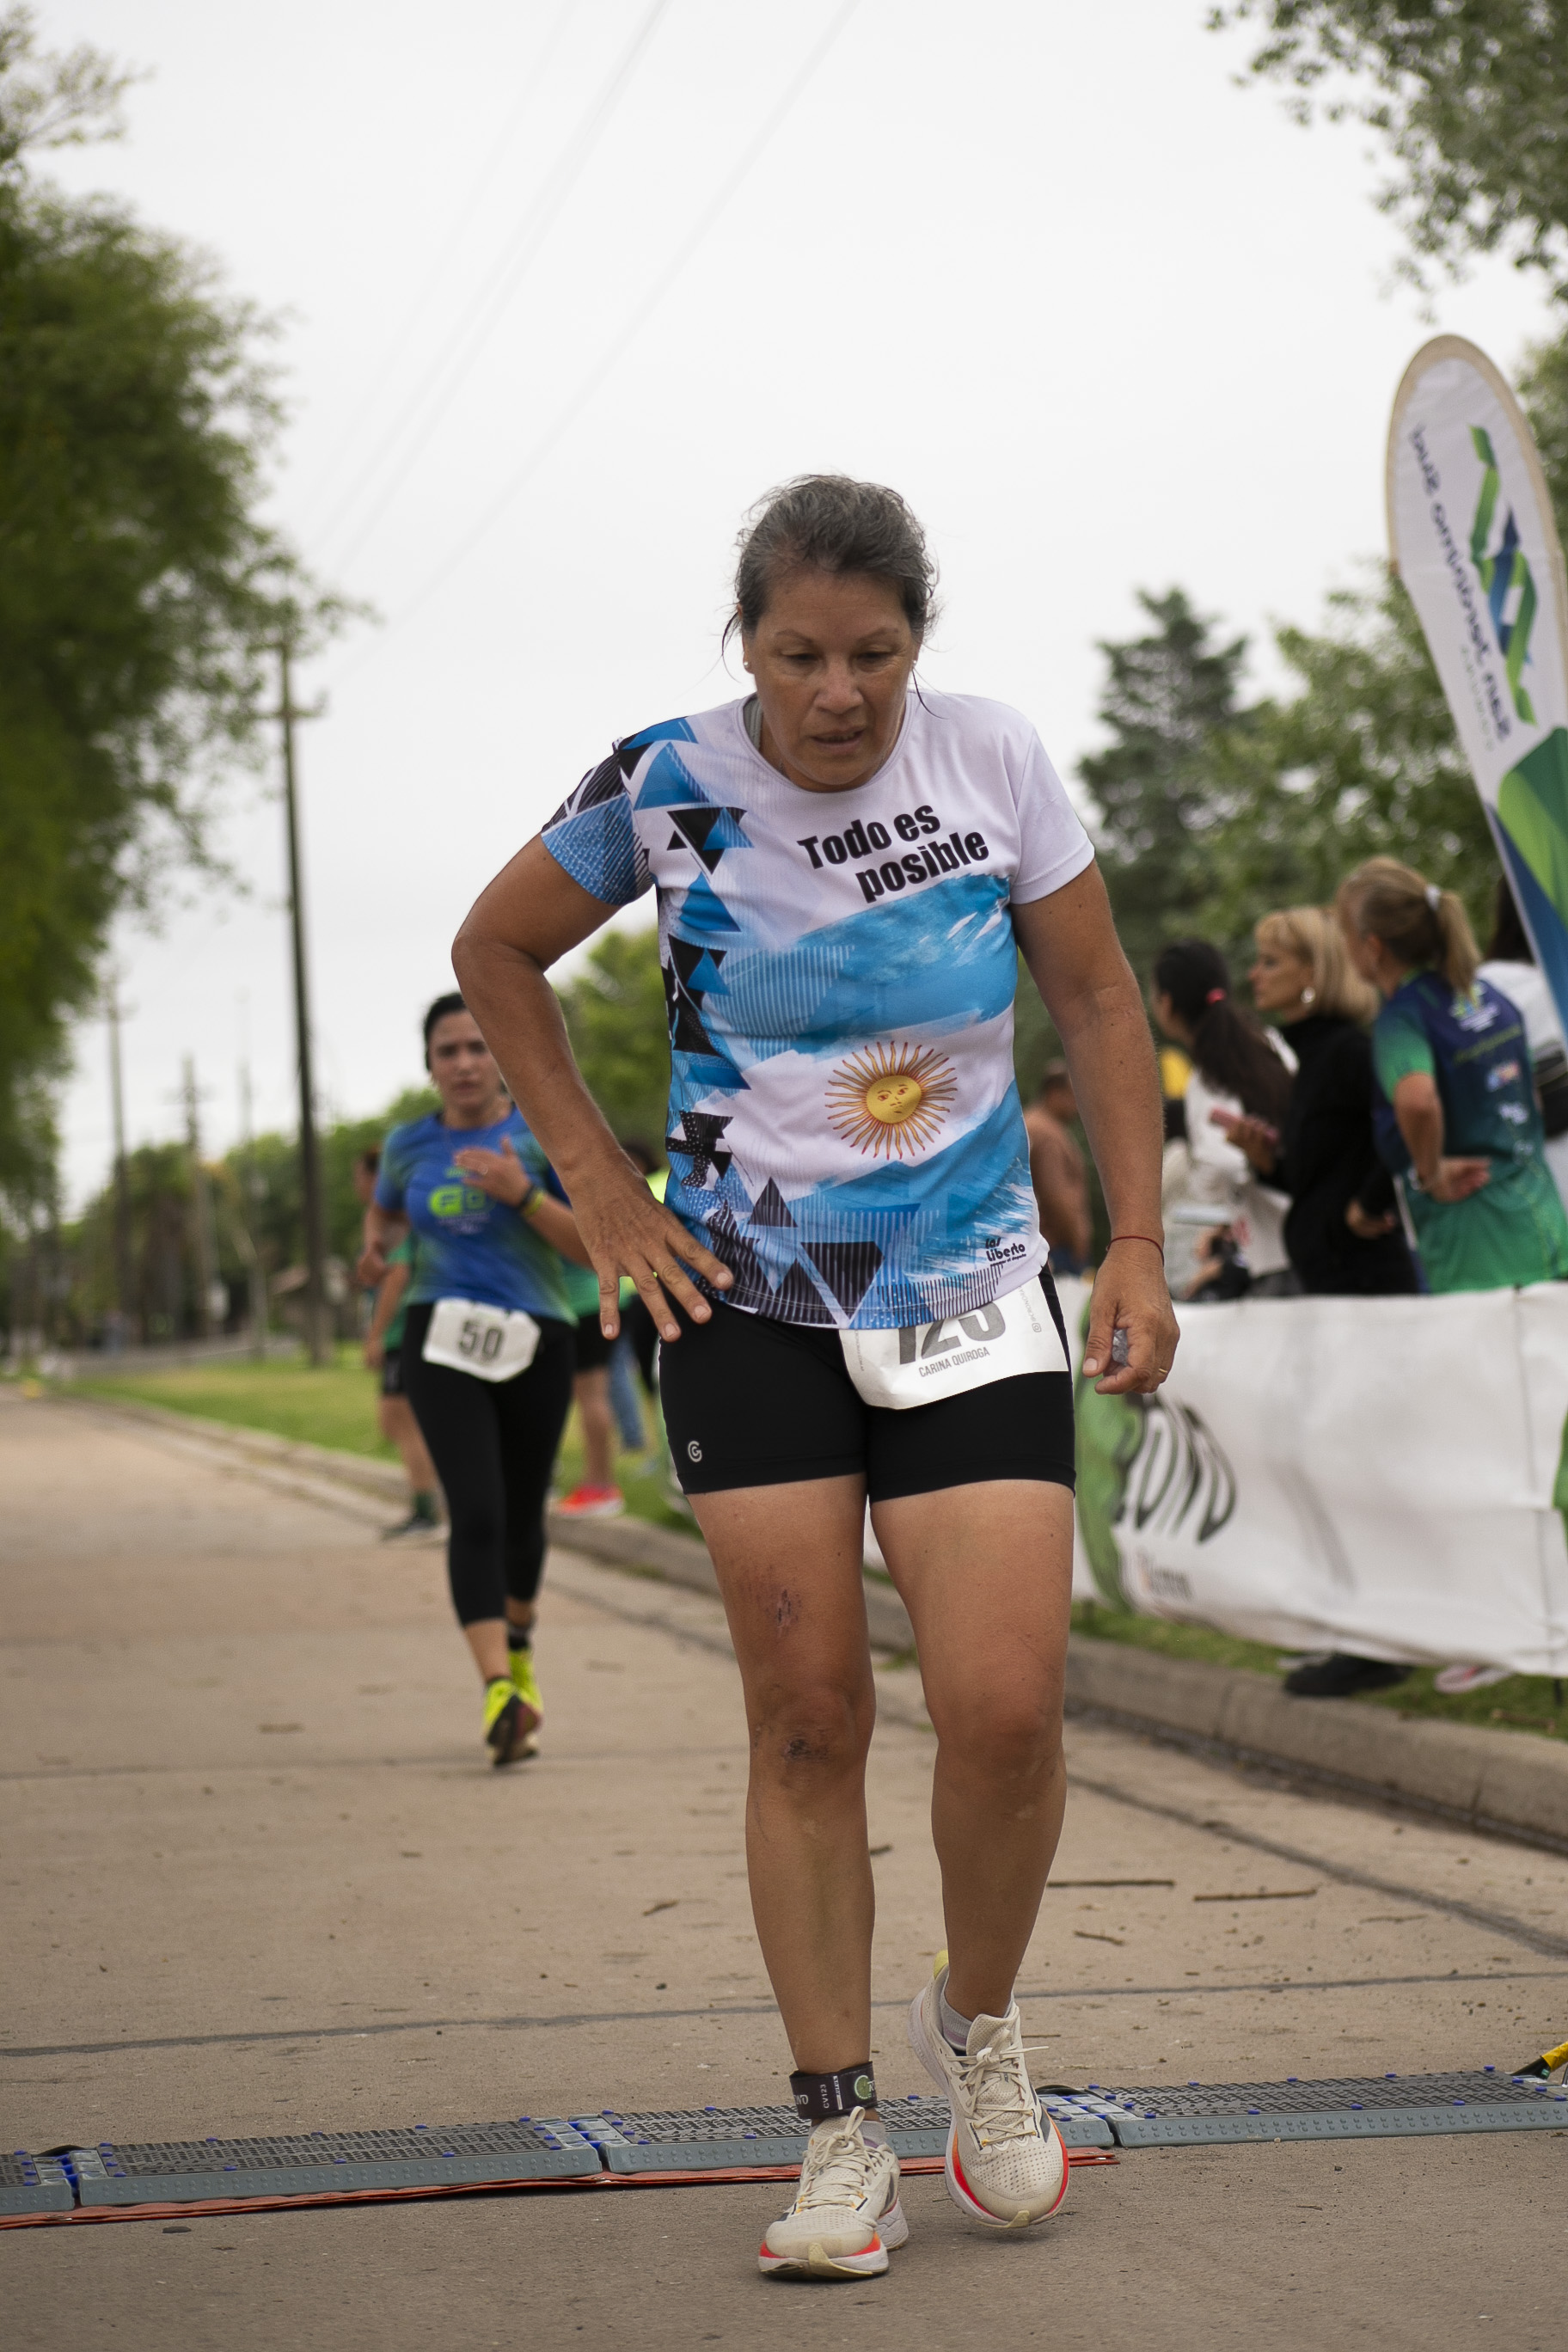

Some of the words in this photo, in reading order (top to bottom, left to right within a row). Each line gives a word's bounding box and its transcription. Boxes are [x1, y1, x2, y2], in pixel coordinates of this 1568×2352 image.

[797, 819, 891, 869] Todo
[894, 805, 940, 842] es
[855, 831, 989, 903] posible
[458, 1320, 505, 1363] 50
[918, 1358, 952, 1377] CARINA
[952, 1346, 990, 1366] QUIROGA
[819, 2084, 830, 2109] CV123
